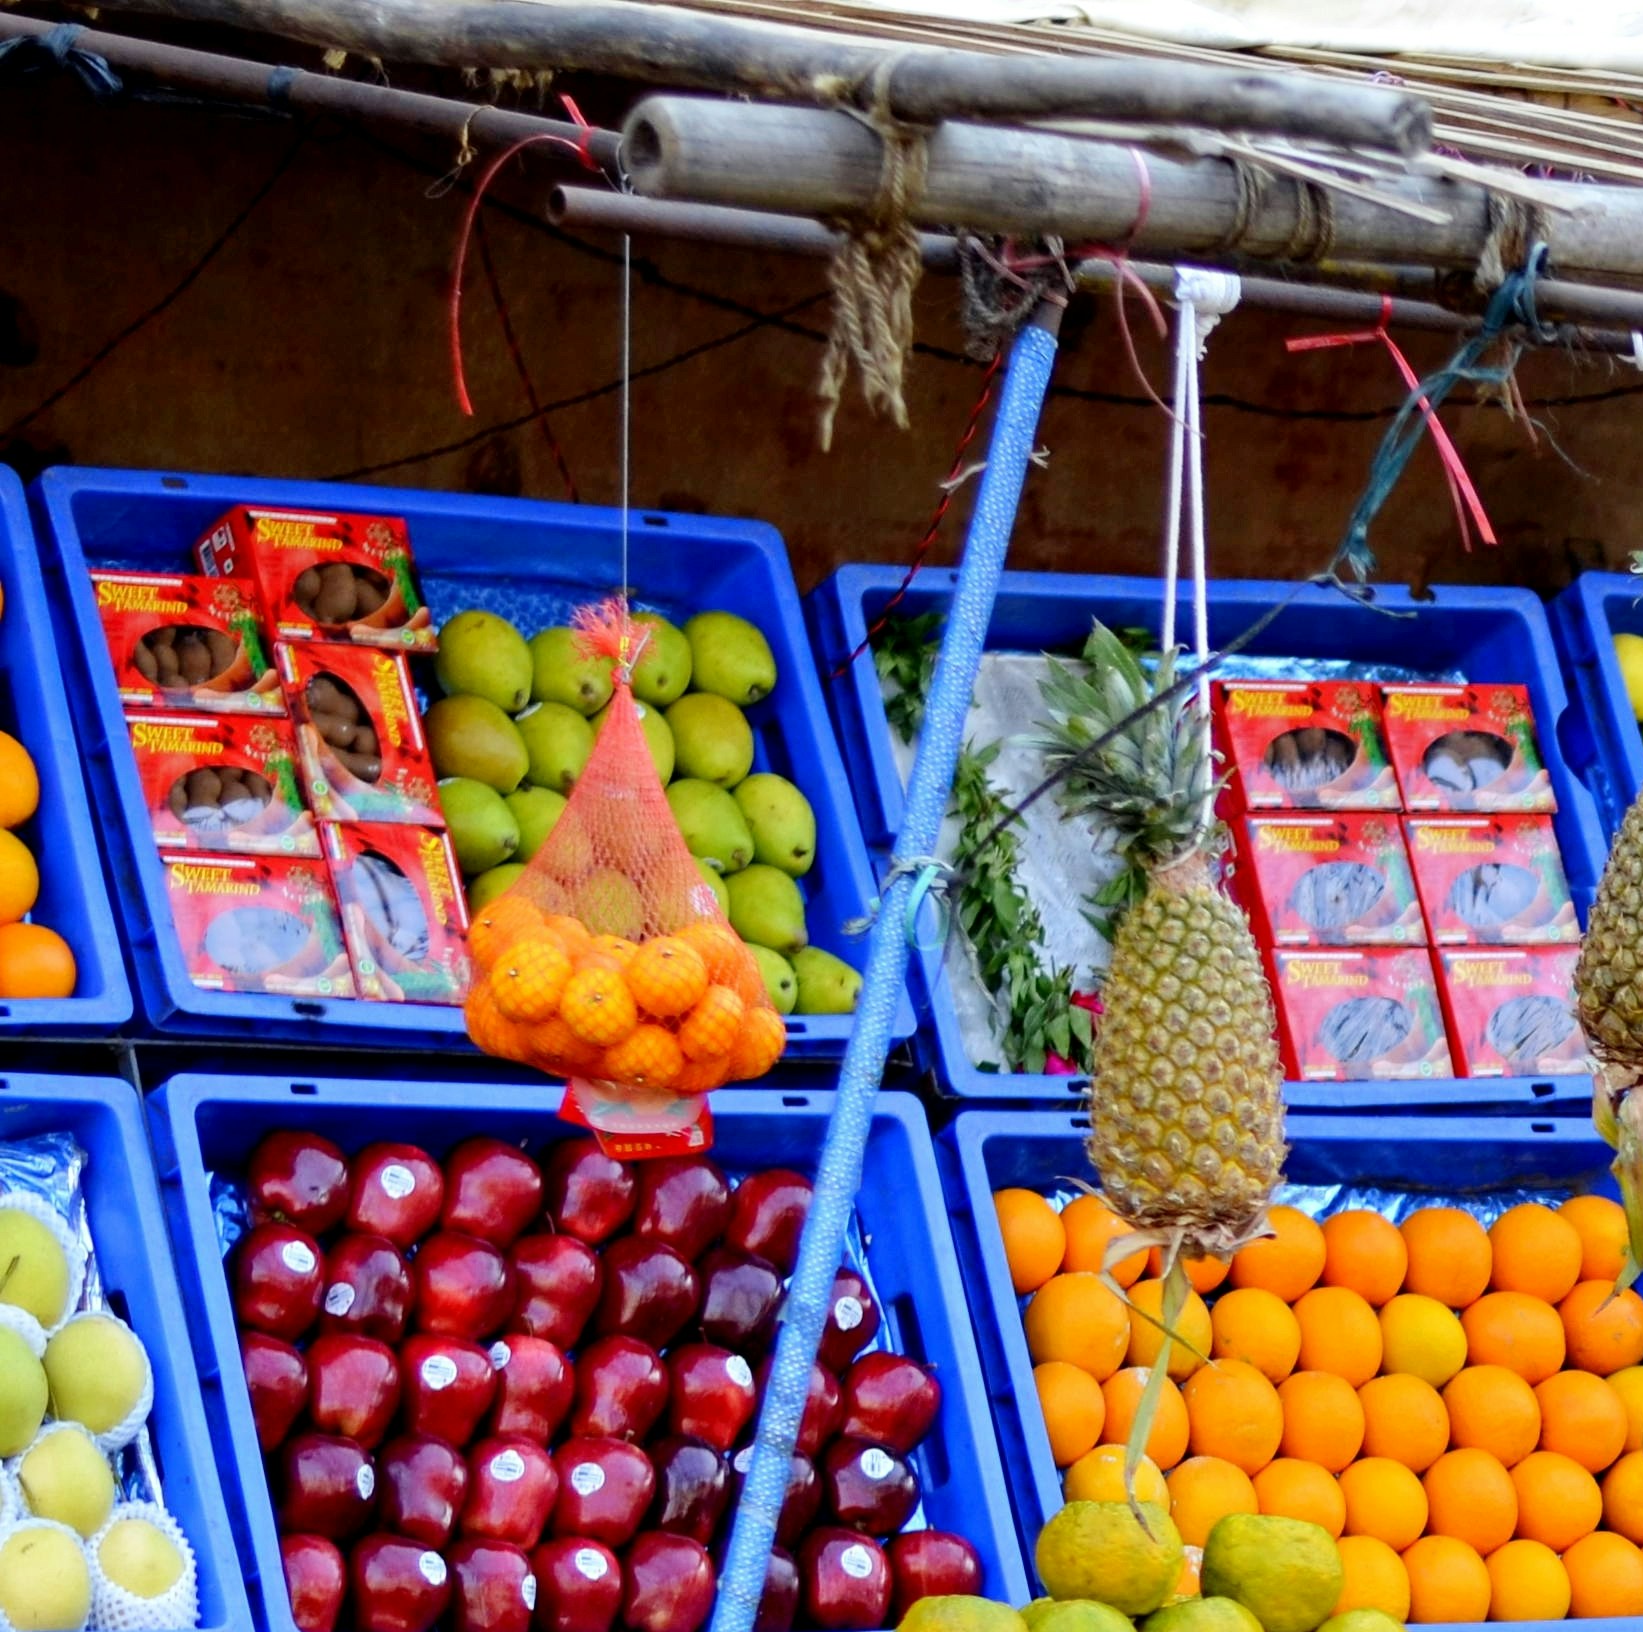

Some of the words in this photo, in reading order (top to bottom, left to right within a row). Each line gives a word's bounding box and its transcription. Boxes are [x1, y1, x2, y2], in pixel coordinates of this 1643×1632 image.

[256, 517, 315, 543] SWEET
[272, 530, 344, 551] TAMARIND
[98, 581, 159, 607] SWEET
[115, 594, 188, 614] TAMARIND
[1230, 690, 1287, 714] SWEET
[132, 722, 194, 748] SWEET
[150, 737, 224, 755] TAMARIND
[1258, 825, 1314, 850] SWEET
[1273, 838, 1341, 854] TAMARIND
[1415, 827, 1471, 851] SWEET
[1433, 838, 1496, 854] TAMARIND
[170, 863, 233, 889] SWEET
[187, 878, 261, 896] TAMARIND
[1286, 959, 1343, 985] SWEET
[1302, 972, 1369, 988] TAMARIND
[1452, 960, 1508, 985] SWEET
[1467, 971, 1533, 987] TAMARIND
